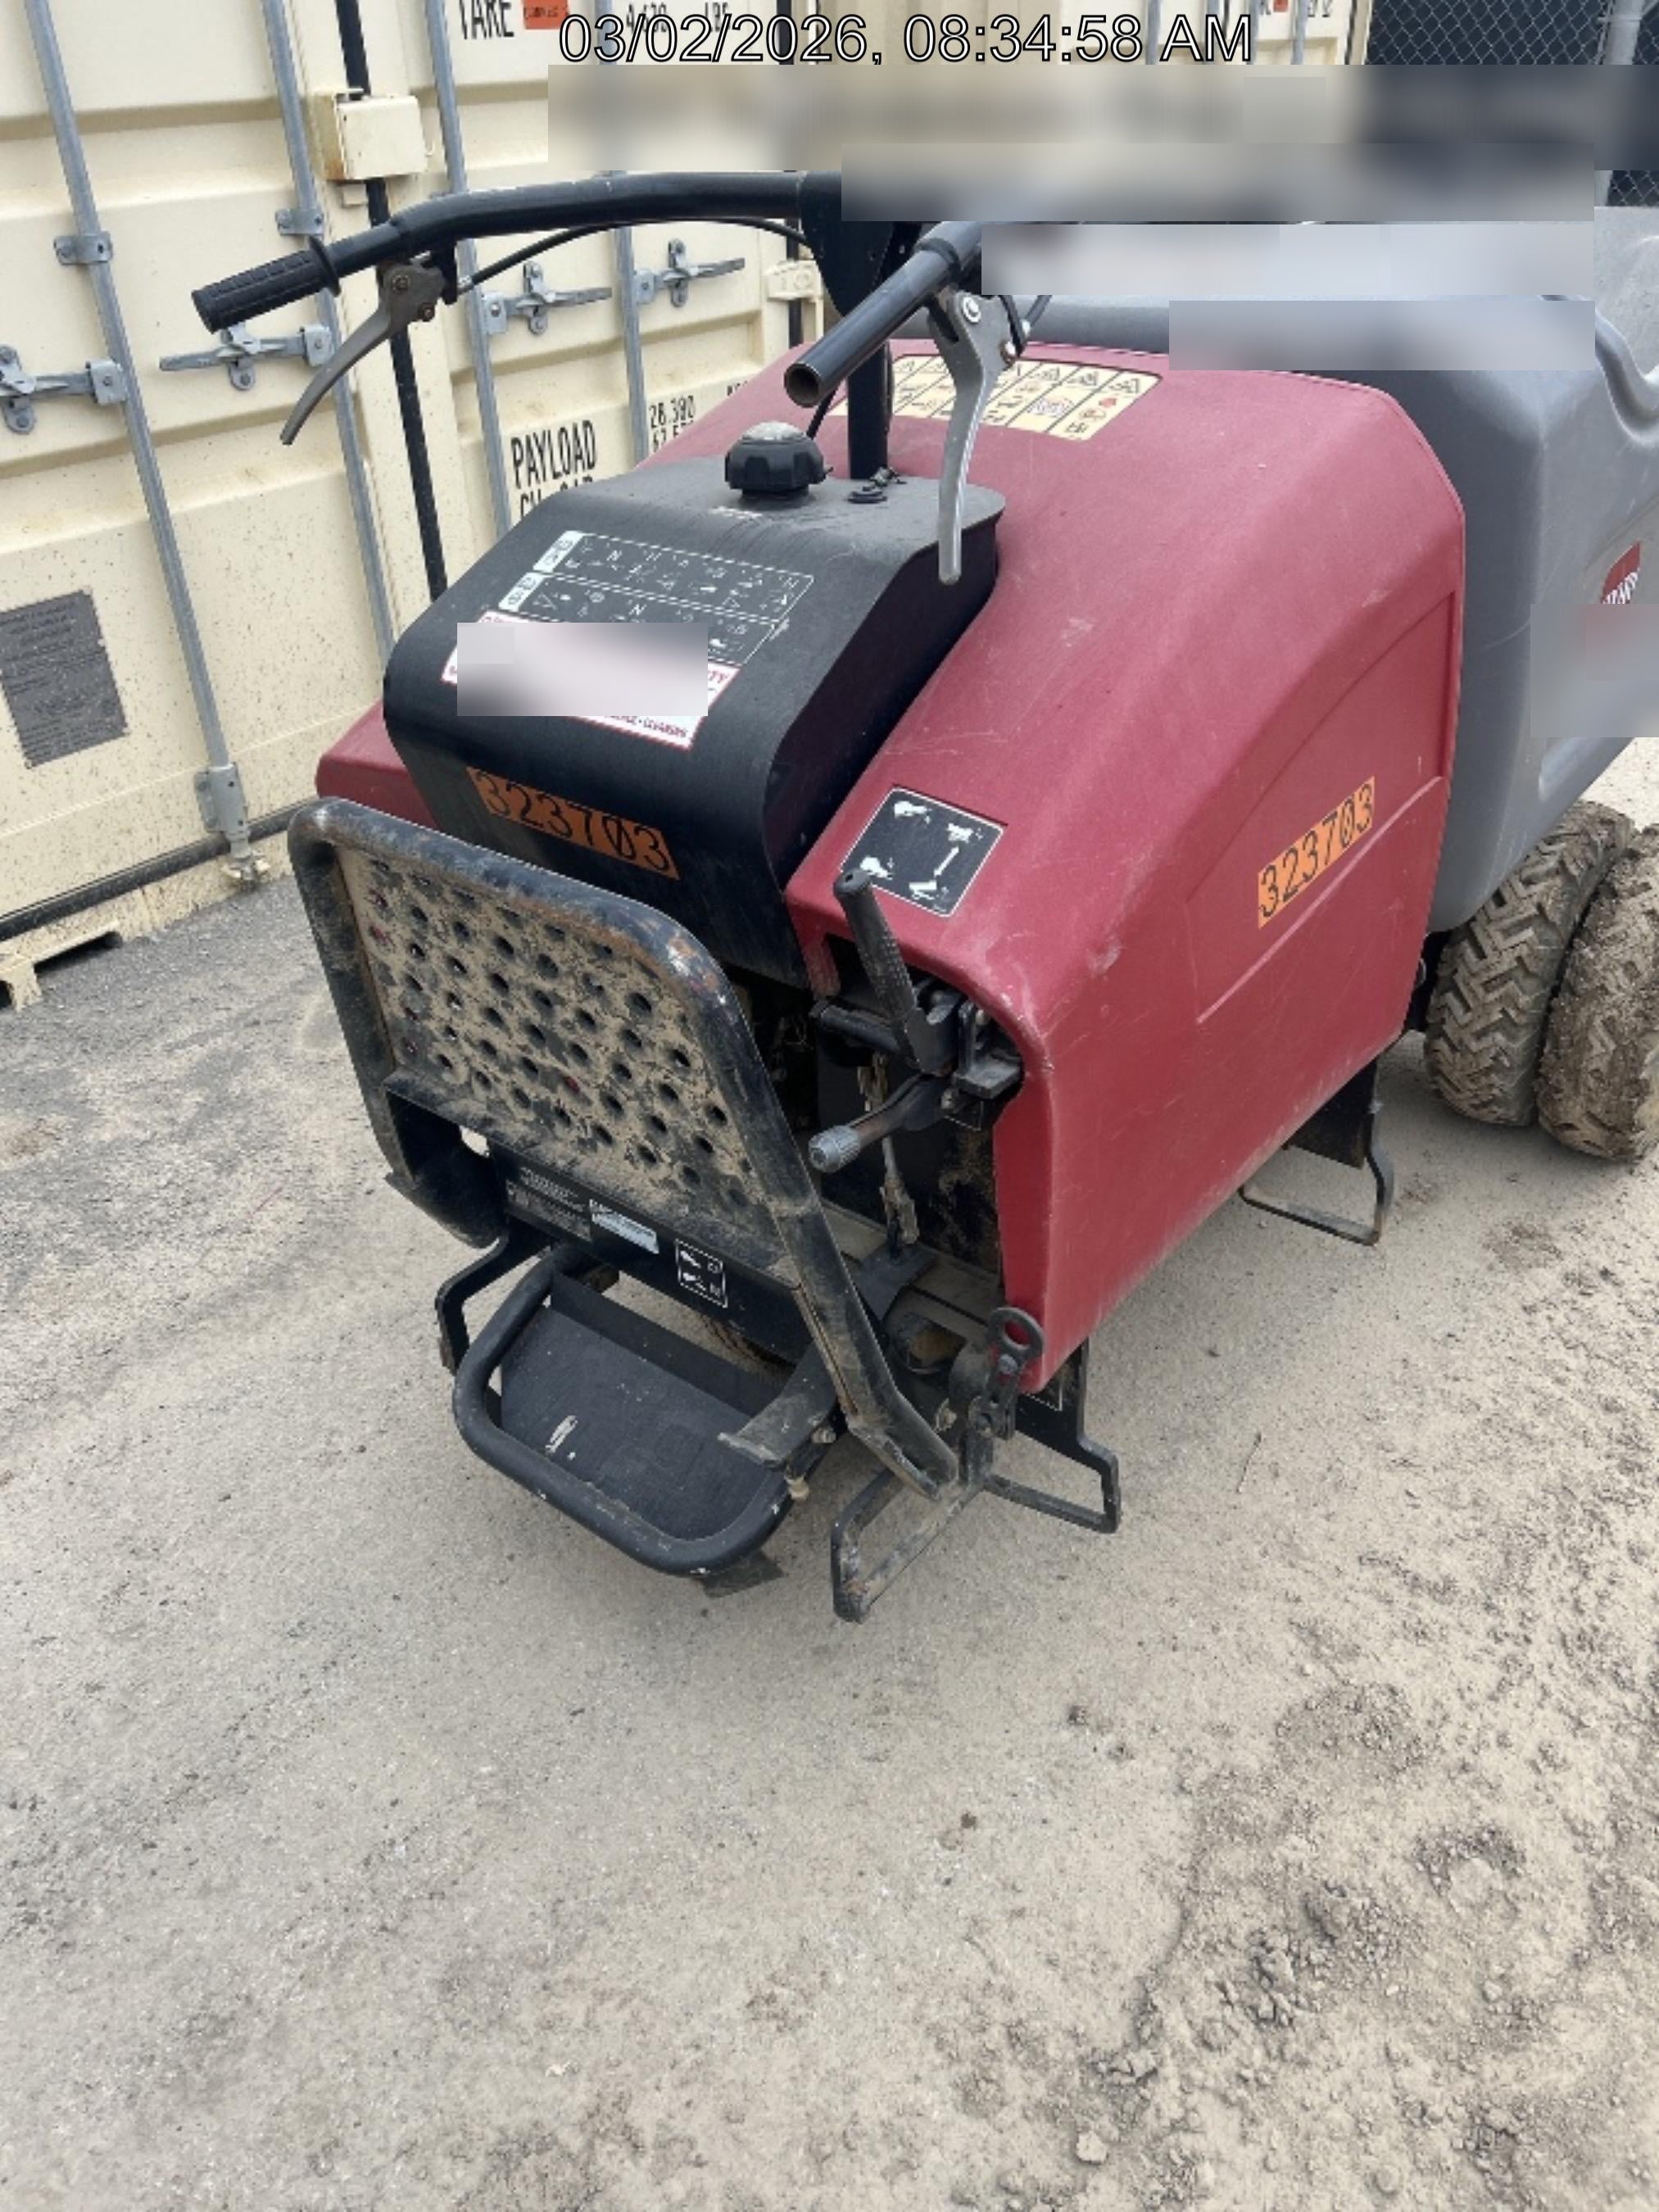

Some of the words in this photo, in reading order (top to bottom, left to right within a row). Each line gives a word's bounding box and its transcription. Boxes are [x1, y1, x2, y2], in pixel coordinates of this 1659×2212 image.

[510, 419, 596, 490] PAYLOAD
[475, 771, 670, 871] 323703
[1261, 782, 1373, 918] 323703
